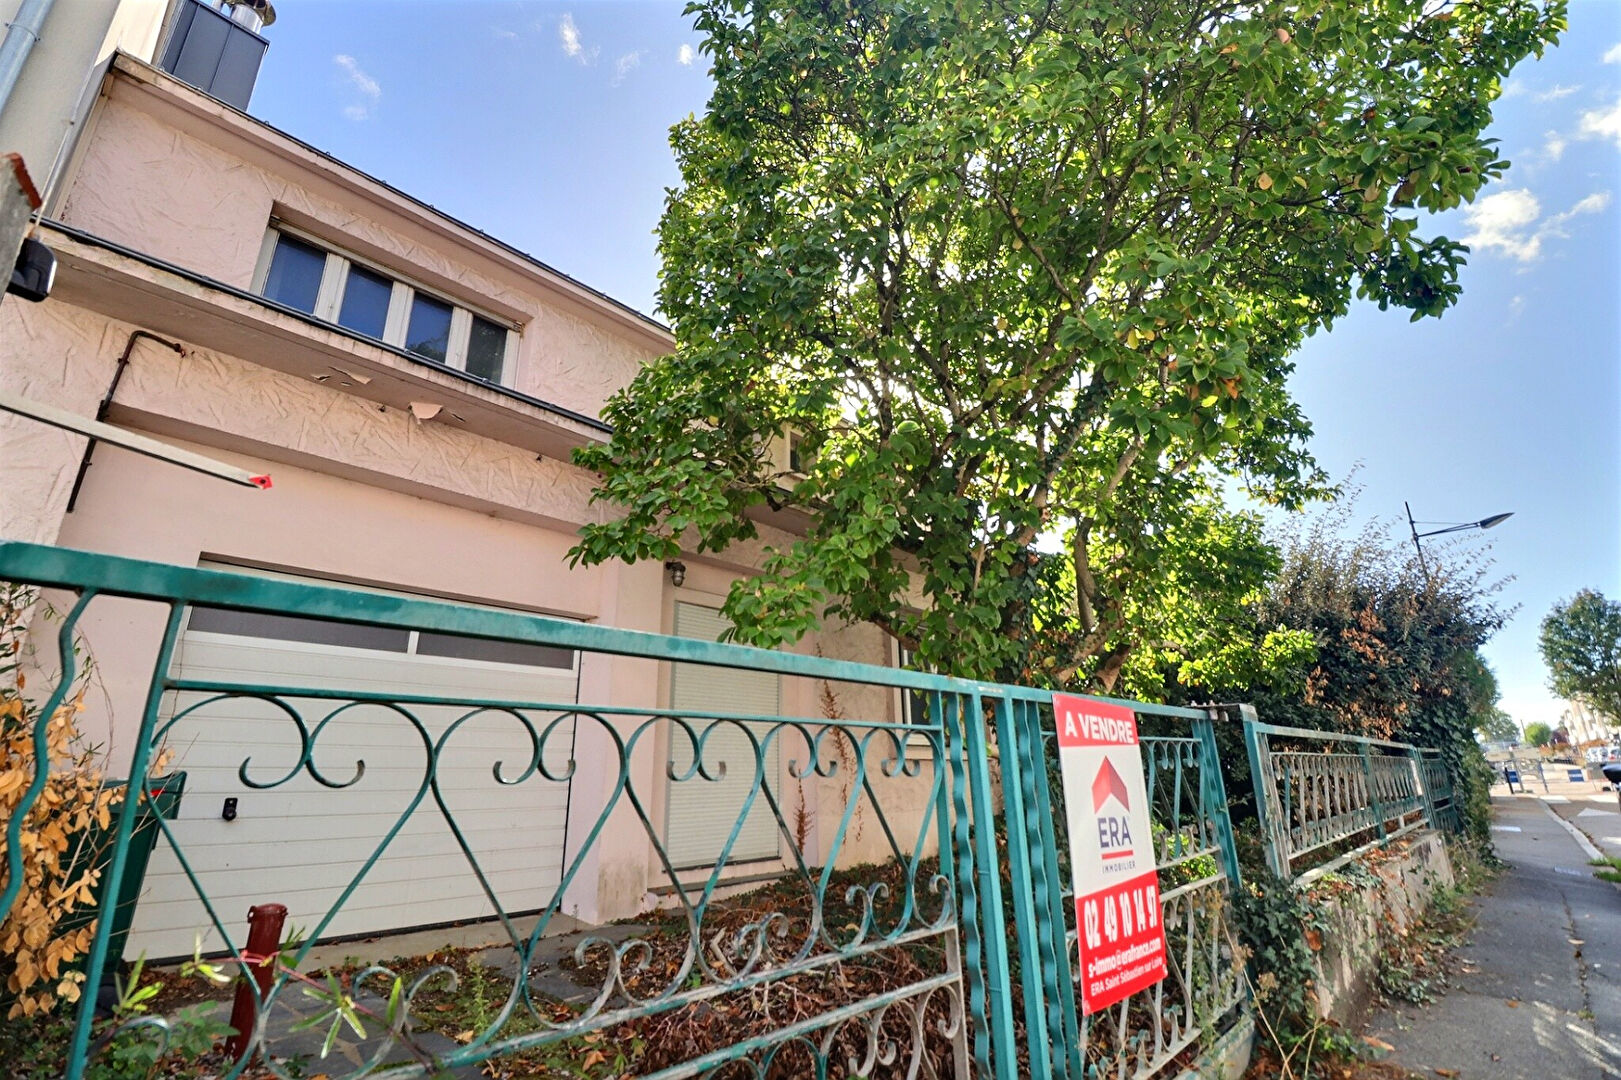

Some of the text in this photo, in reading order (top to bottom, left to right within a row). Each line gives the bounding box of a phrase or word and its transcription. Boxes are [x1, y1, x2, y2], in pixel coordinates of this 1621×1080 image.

[1065, 710, 1135, 744] A VENDRE
[1097, 816, 1132, 848] ERA
[1102, 860, 1136, 874] IMMOBILIER
[1084, 899, 1101, 950] 02
[1104, 895, 1118, 943] 49
[1119, 891, 1133, 938] 10
[1090, 980, 1105, 997] ERA
[1105, 974, 1120, 990] Saint
